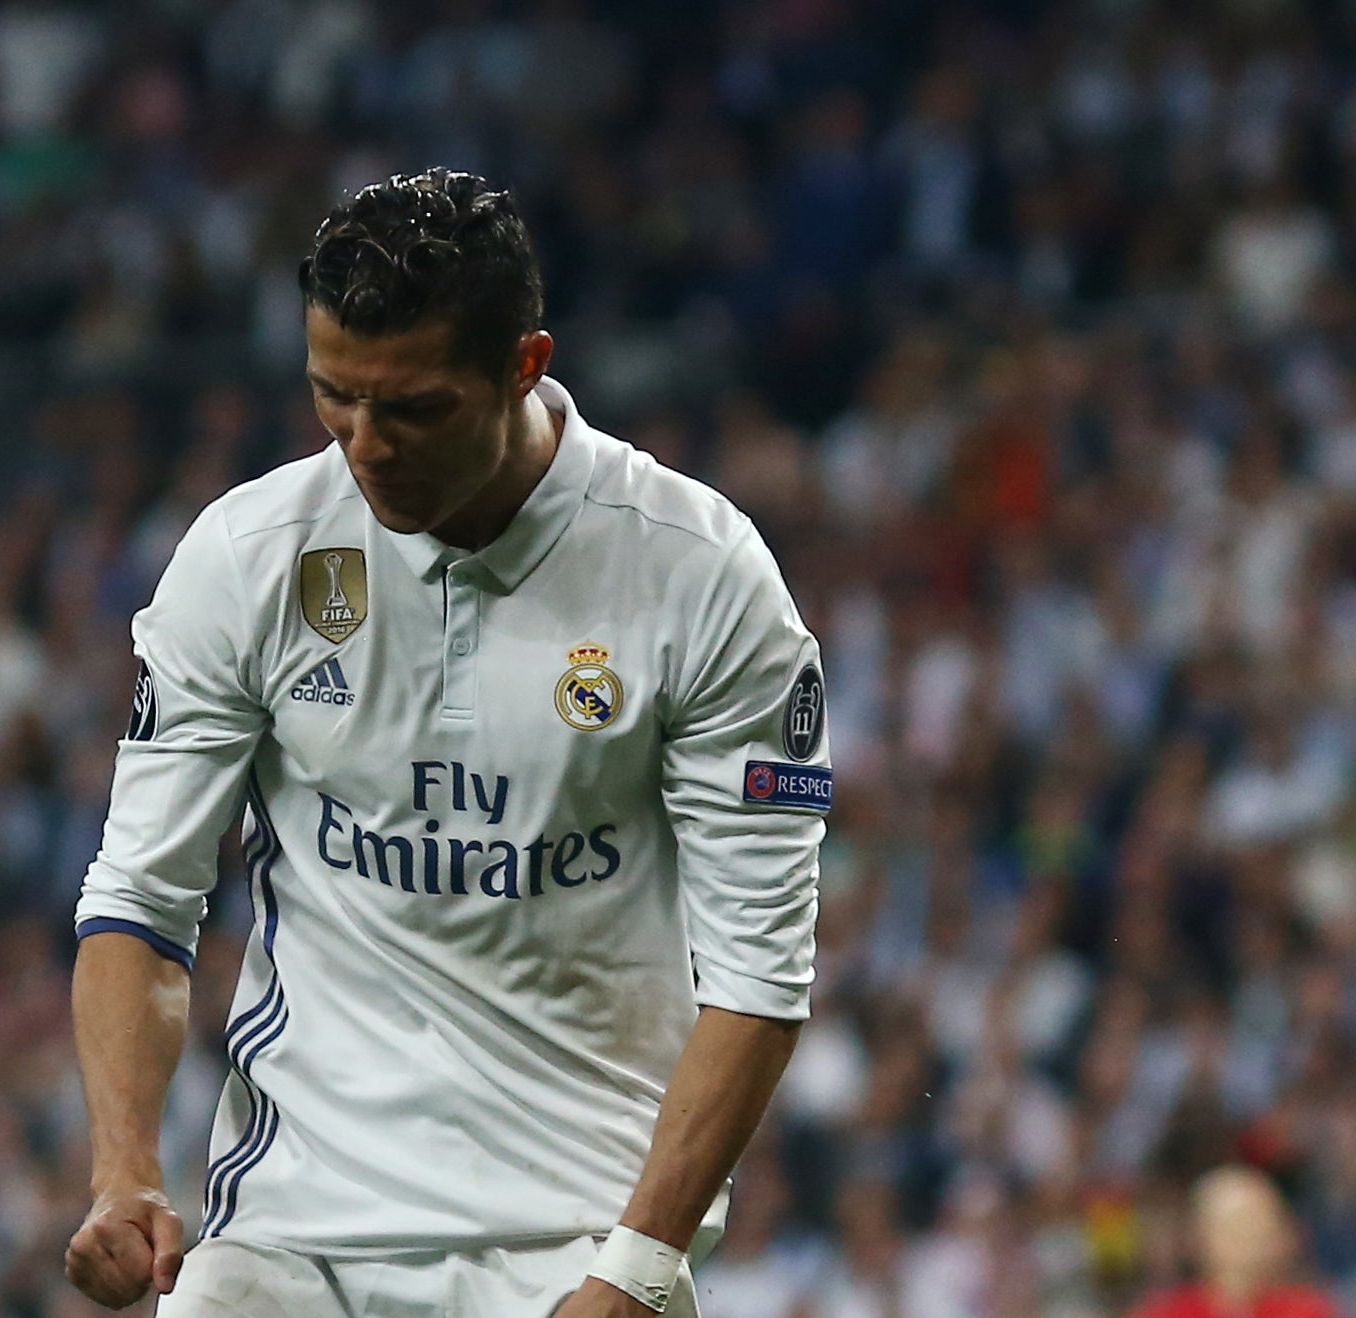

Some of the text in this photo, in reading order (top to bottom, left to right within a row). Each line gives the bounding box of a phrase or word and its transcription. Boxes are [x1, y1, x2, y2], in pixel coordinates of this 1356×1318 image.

[321, 608, 353, 621] FIFA
[291, 686, 355, 706] adidas
[794, 712, 810, 735] 11
[411, 760, 509, 825] Fly
[777, 775, 832, 798] RESPECT
[317, 790, 622, 900] Emirates
